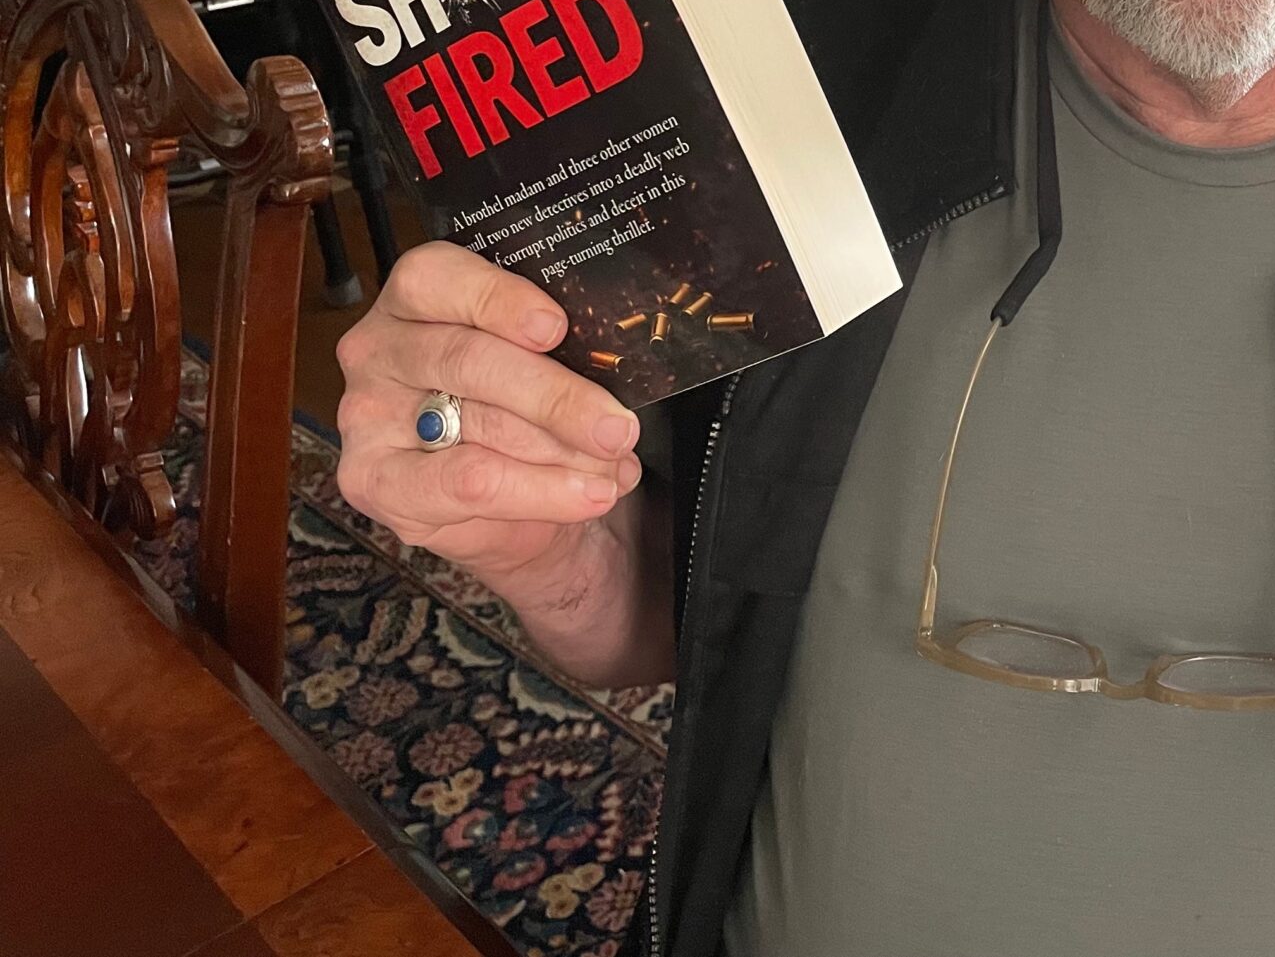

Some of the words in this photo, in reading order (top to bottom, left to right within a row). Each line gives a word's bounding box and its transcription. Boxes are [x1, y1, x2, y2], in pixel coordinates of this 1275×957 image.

[453, 216, 464, 232] A
[461, 195, 504, 227] brothel
[504, 182, 546, 208] madam
[547, 163, 569, 183] and
[568, 158, 599, 176] three
[600, 139, 632, 161] other
[632, 116, 678, 144] women
[487, 228, 509, 245] two
[510, 215, 533, 234] new
[535, 188, 589, 223] detectives
[587, 178, 614, 197] into
[616, 173, 624, 185] a
[624, 151, 663, 180] deadly
[662, 137, 690, 162] web
[494, 252, 503, 268] f
[504, 237, 546, 266] corrupt
[548, 220, 588, 252] politics
[589, 203, 611, 227] and
[611, 191, 647, 217] deceit
[645, 186, 661, 200] in
[661, 173, 686, 193] this
[541, 238, 614, 283] page-turning
[611, 218, 655, 247] thriller.
